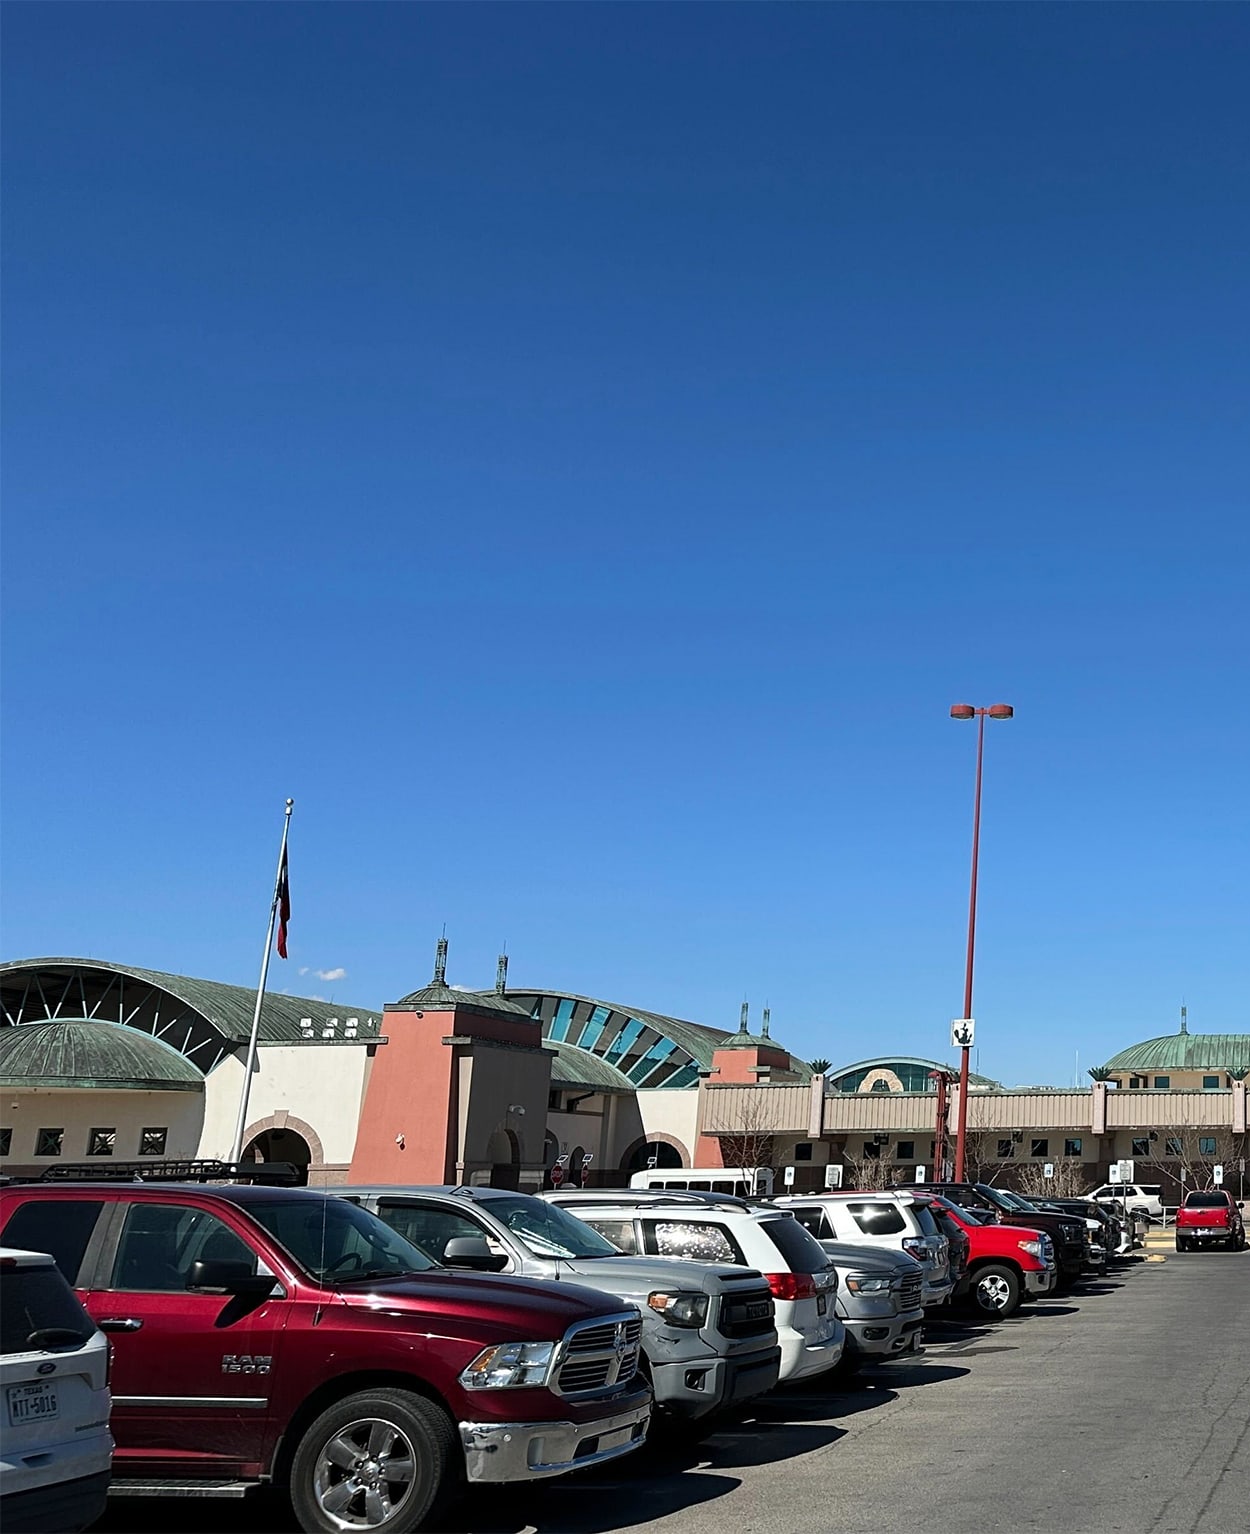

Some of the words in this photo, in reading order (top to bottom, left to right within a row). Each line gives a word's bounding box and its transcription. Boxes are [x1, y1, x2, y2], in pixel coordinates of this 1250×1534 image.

[222, 1354, 272, 1365] RAM
[221, 1364, 271, 1375] 1500
[23, 1386, 43, 1396] TEXAS
